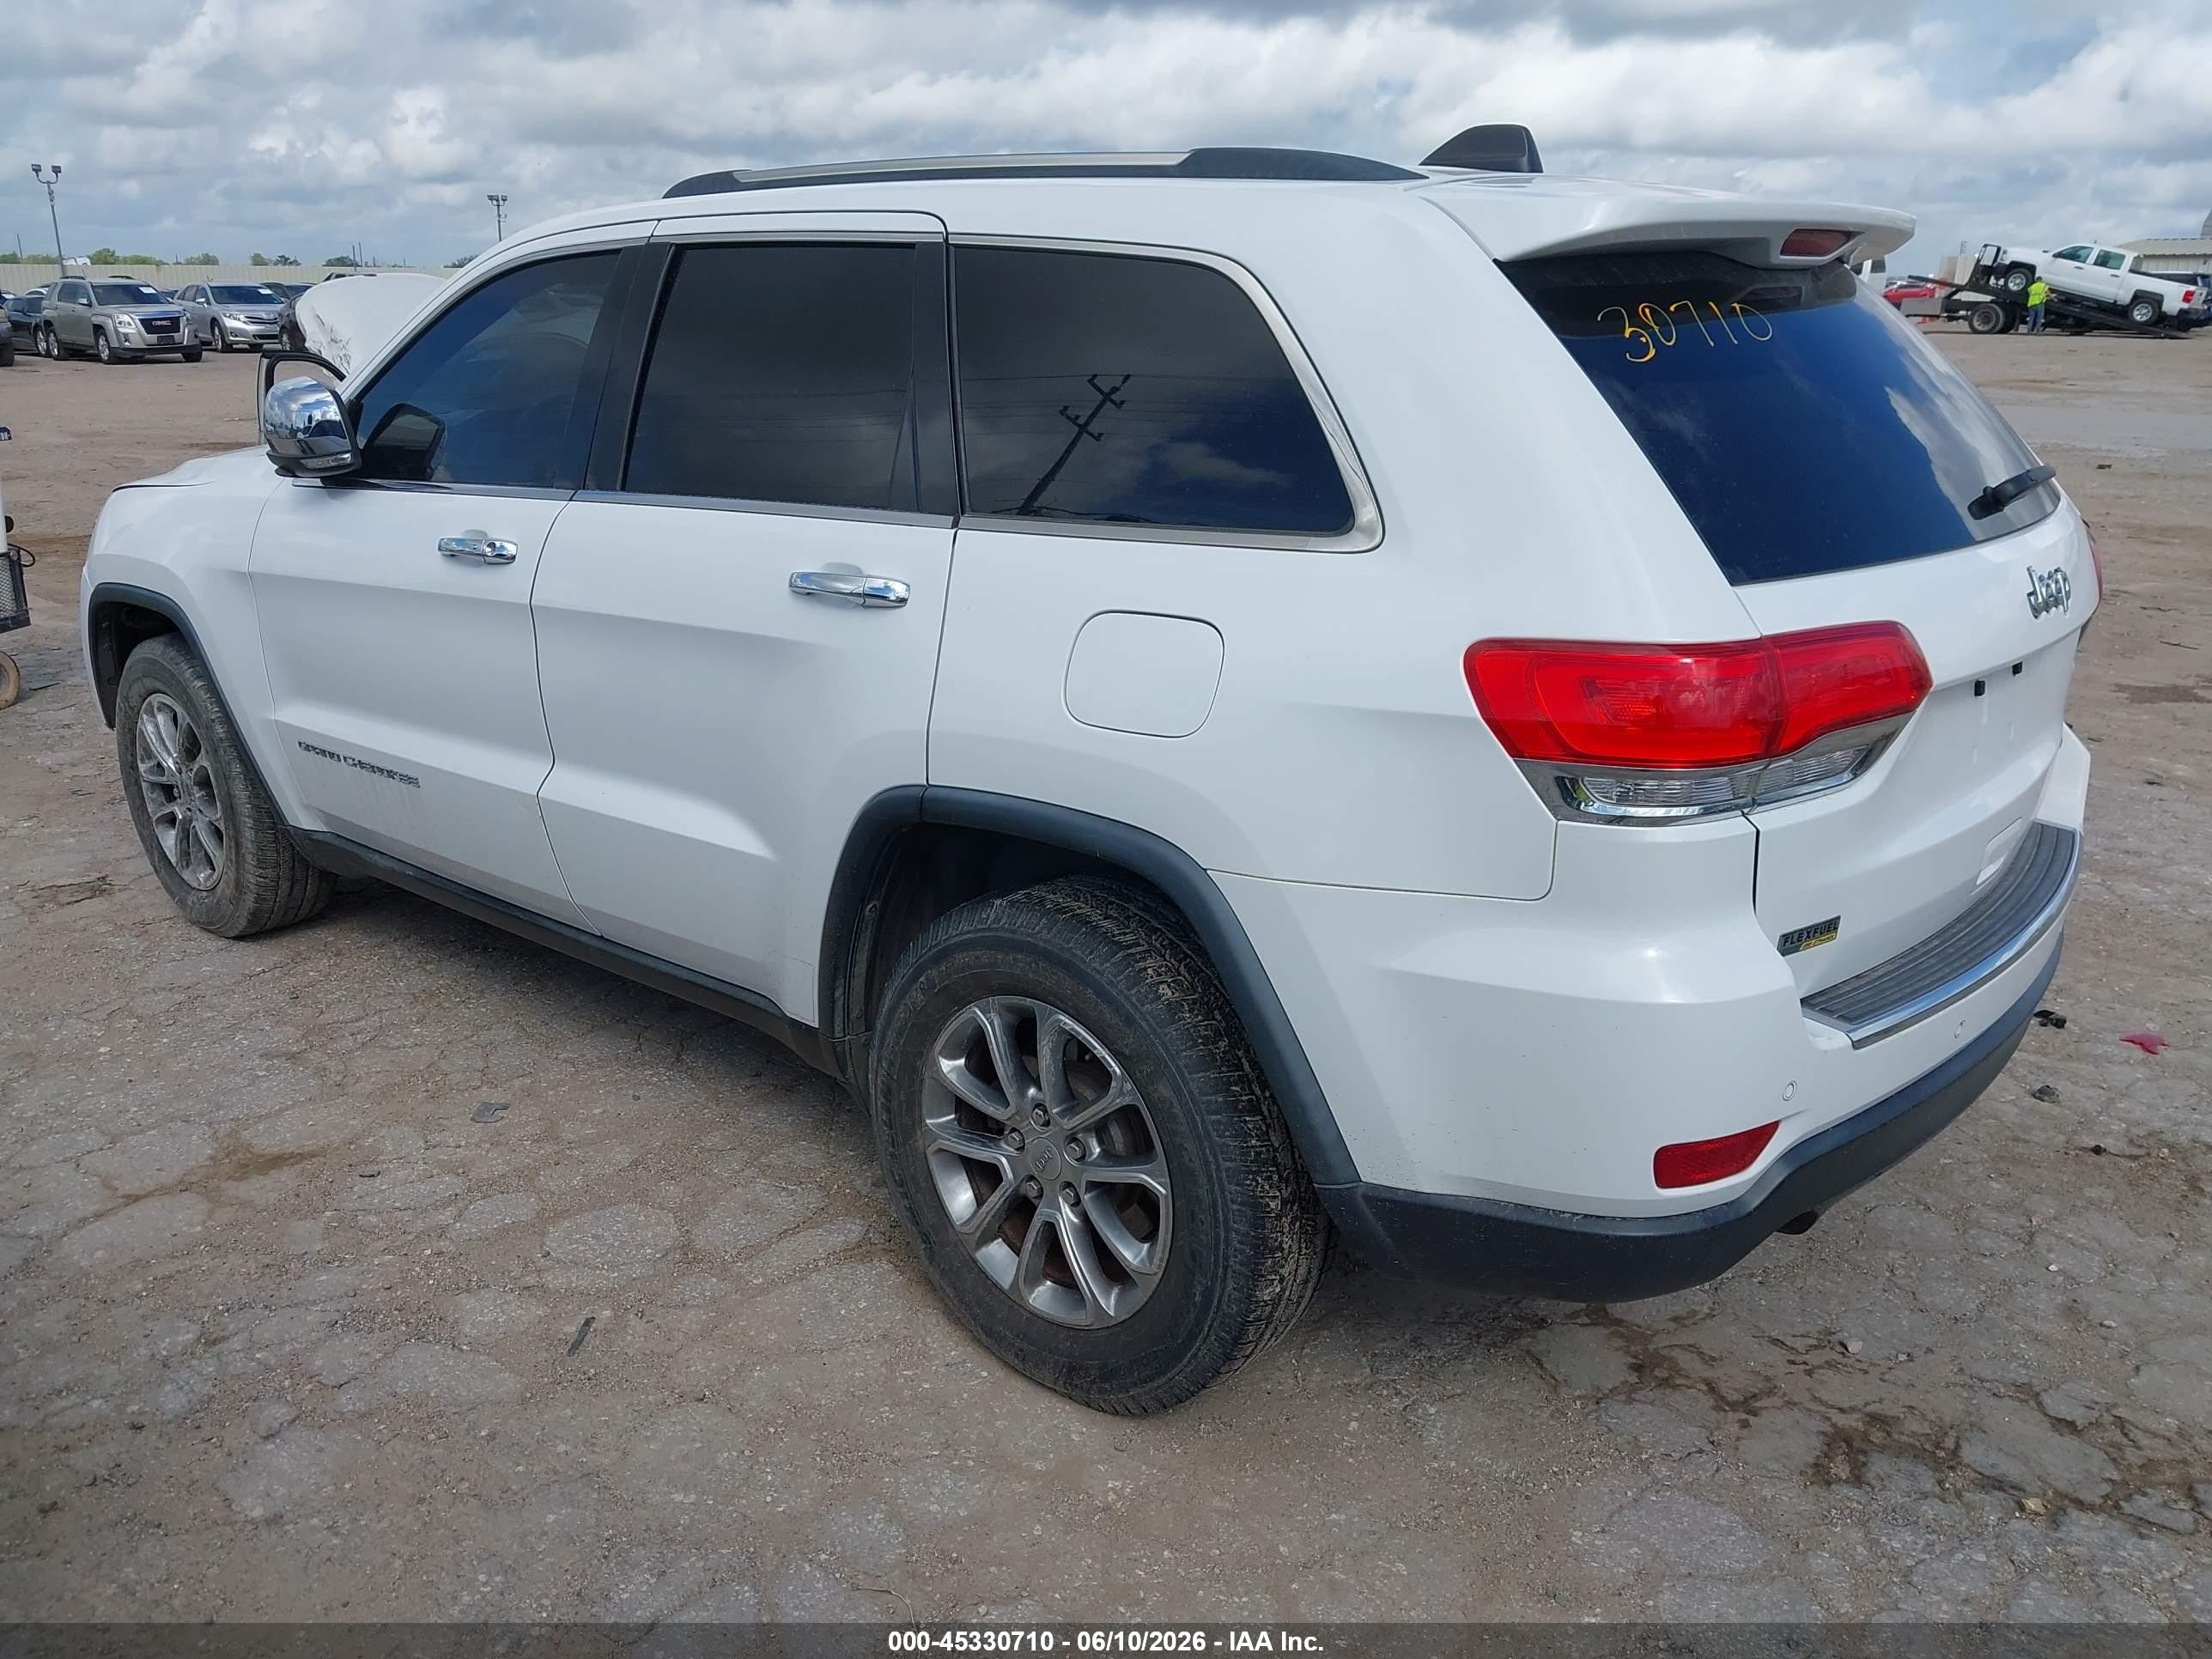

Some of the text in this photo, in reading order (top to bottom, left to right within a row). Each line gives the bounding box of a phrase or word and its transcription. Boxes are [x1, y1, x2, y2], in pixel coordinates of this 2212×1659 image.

[1595, 299, 1774, 364] 30710
[2026, 564, 2072, 620] Jeep
[297, 740, 342, 763] GRAND
[1782, 921, 1839, 949] FLEXFUEL
